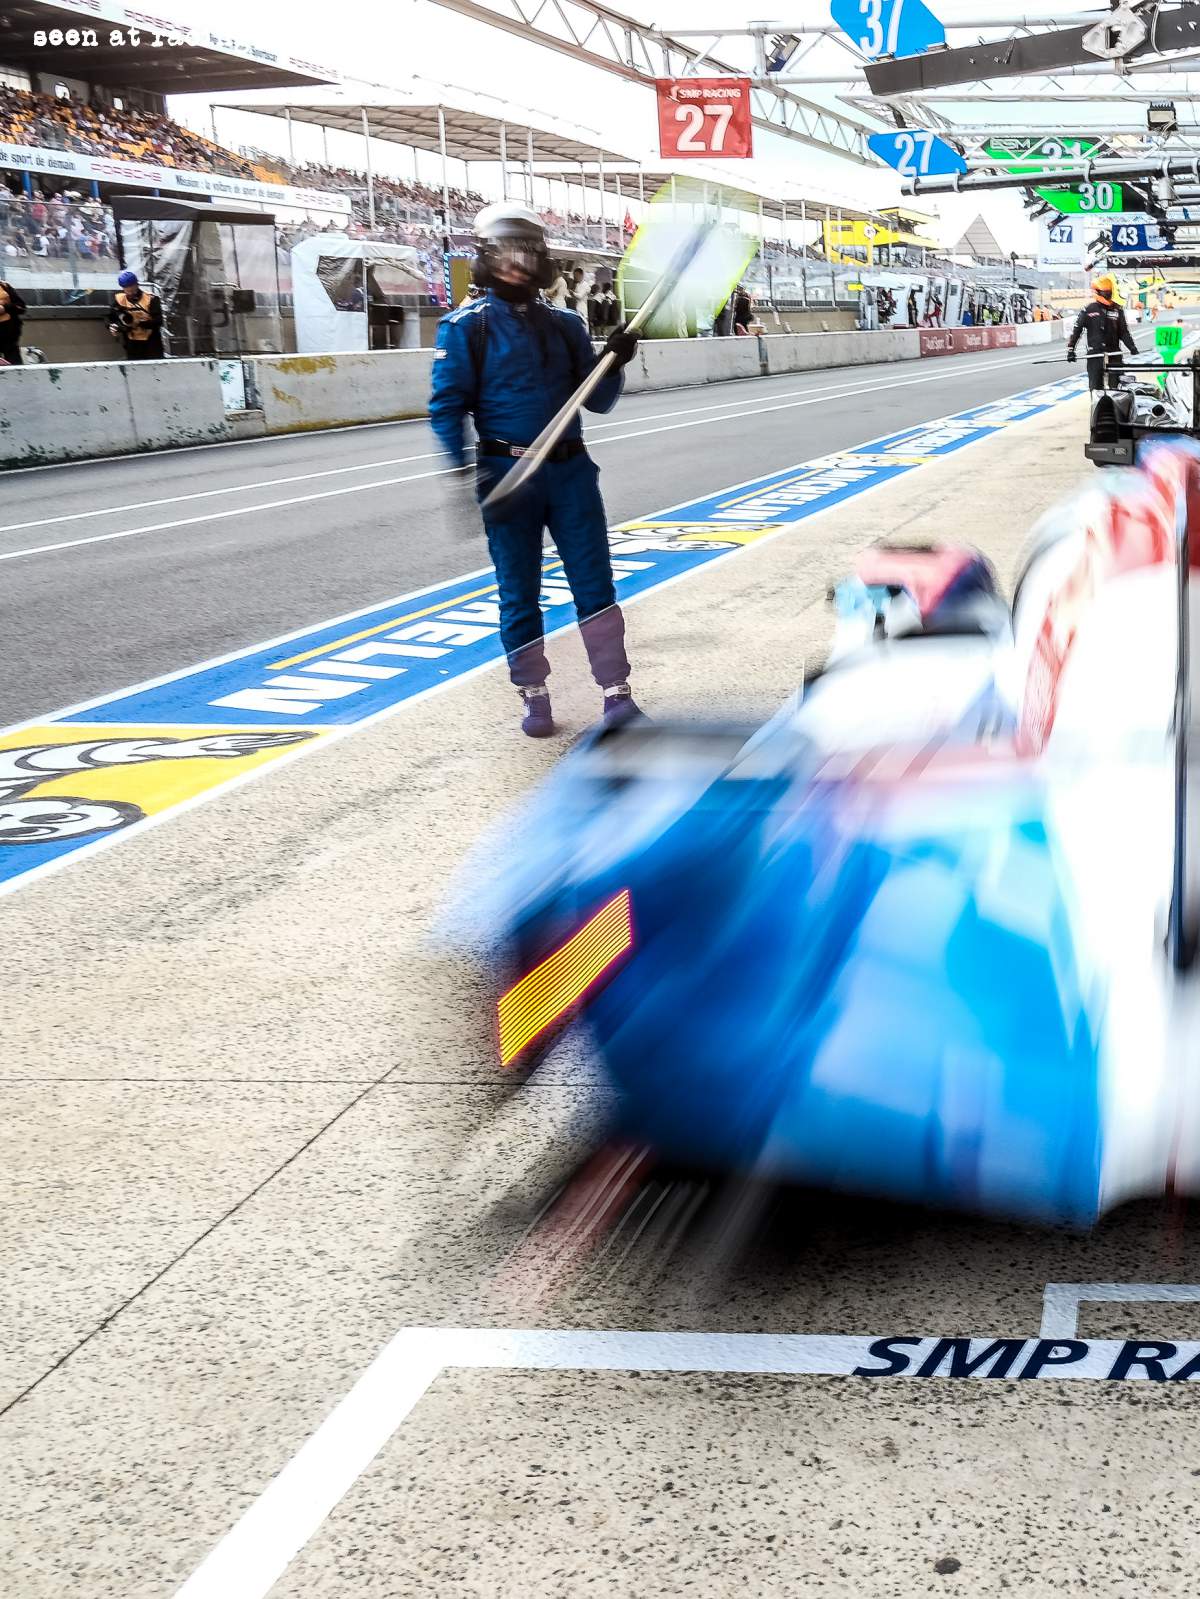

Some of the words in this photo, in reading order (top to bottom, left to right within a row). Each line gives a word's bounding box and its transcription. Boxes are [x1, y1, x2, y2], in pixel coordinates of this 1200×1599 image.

[679, 89, 702, 98] SMP
[703, 88, 741, 98] RACING
[674, 104, 734, 151] 27
[894, 131, 934, 176] 27
[1078, 182, 1114, 210] 30
[1050, 225, 1071, 242] 47
[1116, 226, 1139, 246] 43
[853, 1336, 1089, 1378] SMP
